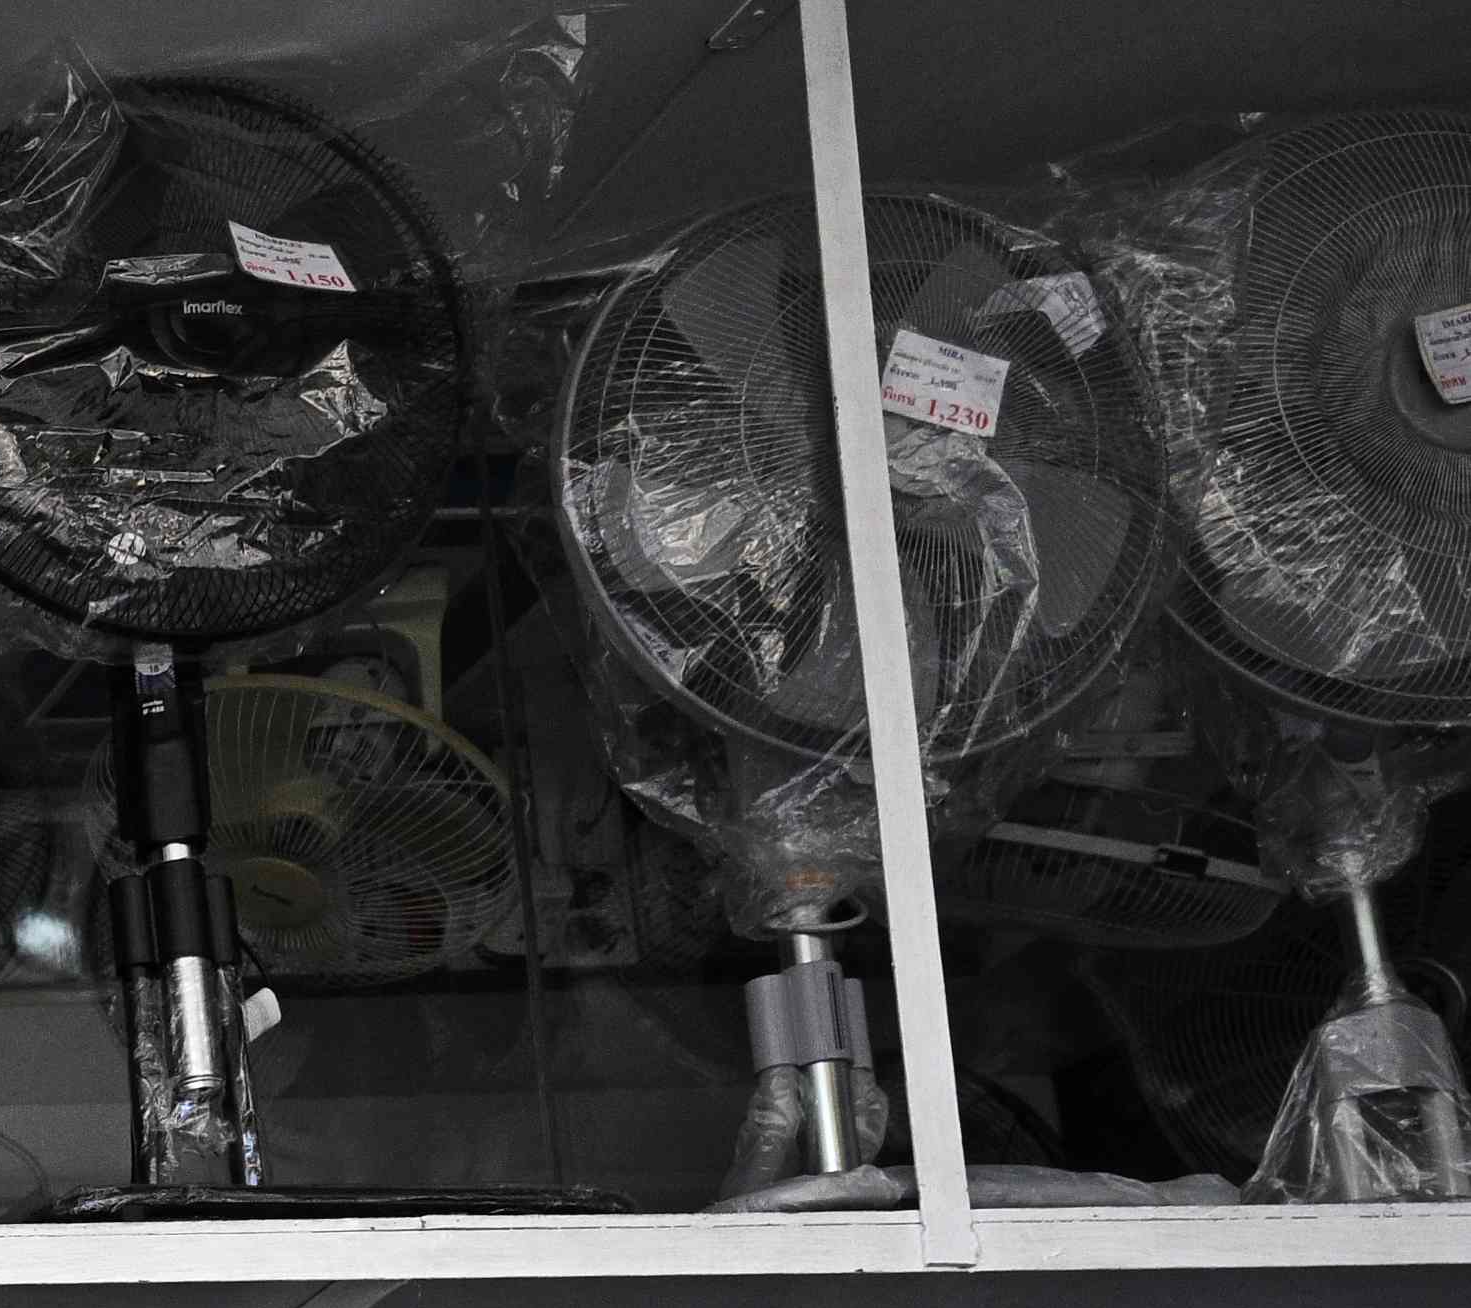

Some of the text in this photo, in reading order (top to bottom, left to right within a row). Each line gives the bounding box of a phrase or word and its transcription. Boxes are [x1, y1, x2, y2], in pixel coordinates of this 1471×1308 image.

[286, 270, 346, 289] 1,150
[183, 301, 243, 314] imarflex
[929, 399, 990, 430] 1,230
